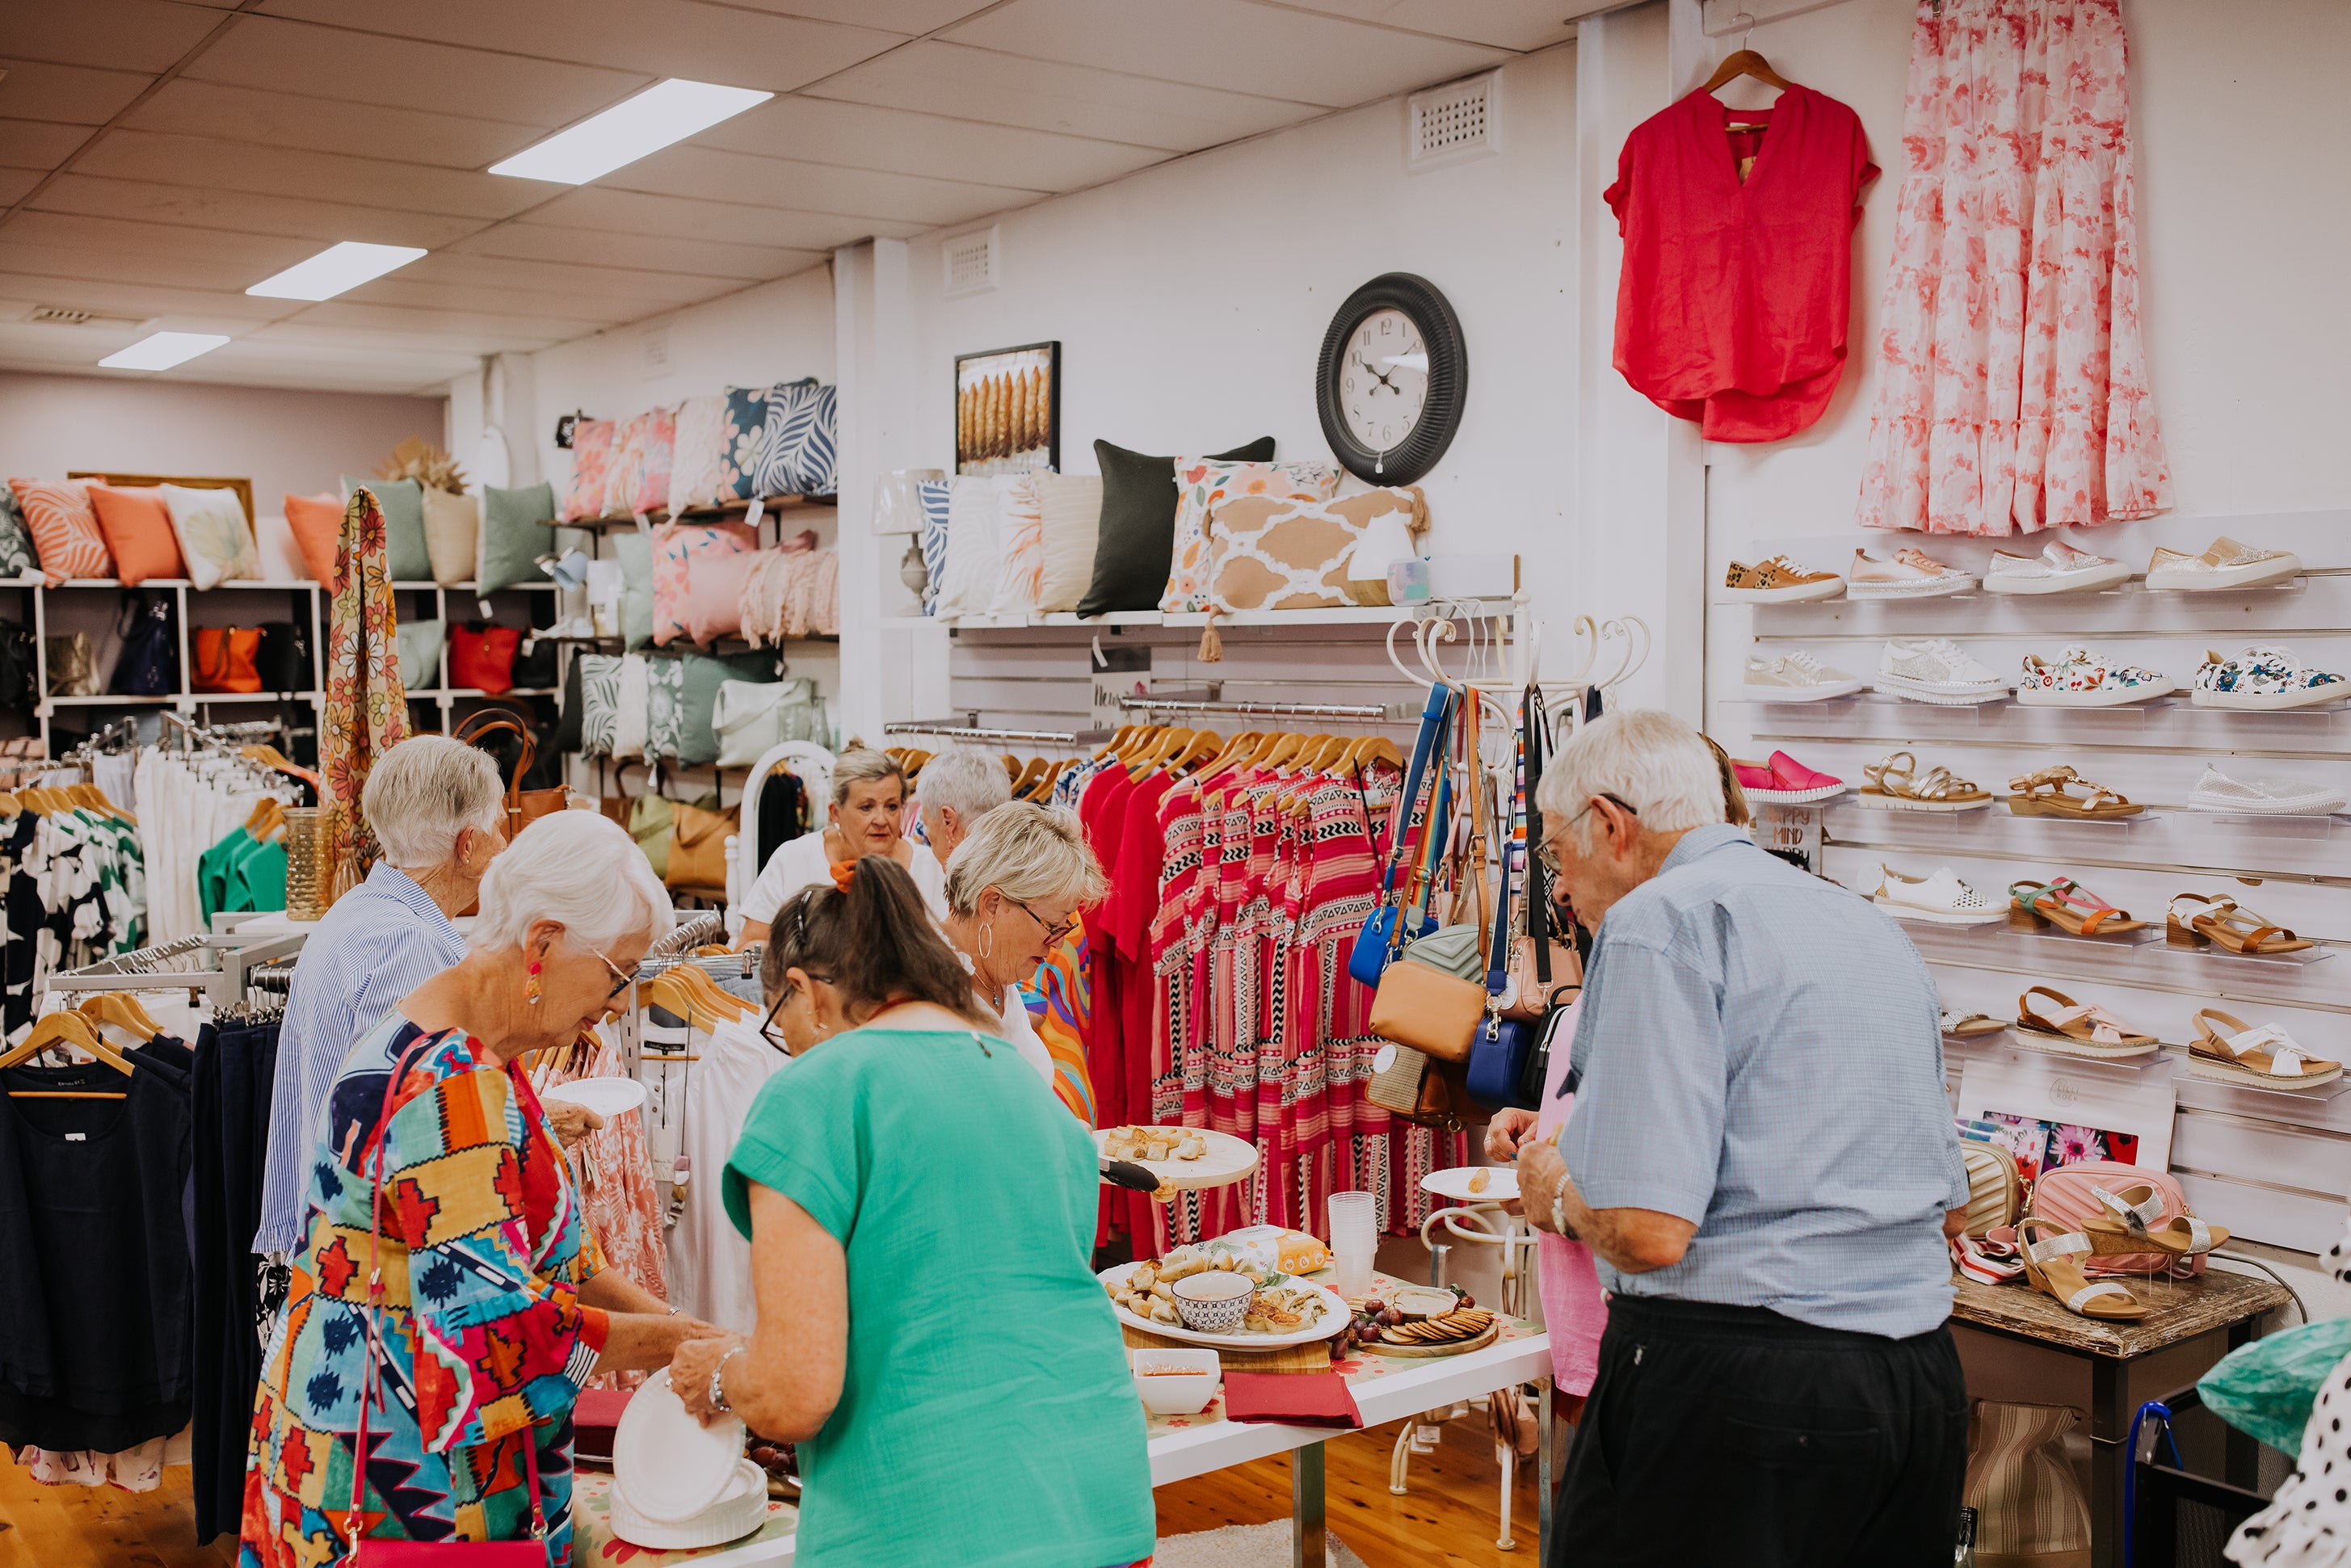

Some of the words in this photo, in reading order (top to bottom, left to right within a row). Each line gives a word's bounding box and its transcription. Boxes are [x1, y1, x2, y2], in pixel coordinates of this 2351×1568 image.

[1380, 317, 1392, 336] 12
[1363, 330, 1371, 346] 11
[1351, 350, 1363, 367] 10
[1345, 377, 1355, 394] 9
[1414, 393, 1423, 409] 4
[1352, 404, 1361, 421] 8
[1367, 422, 1374, 437] 7
[1402, 414, 1411, 431] 5
[1382, 424, 1391, 442] 6
[1766, 807, 1810, 826] HAPPY
[1773, 827, 1803, 845] MIND
[2057, 1086, 2079, 1094] LILLI
[2057, 1093, 2078, 1101] ROCK
